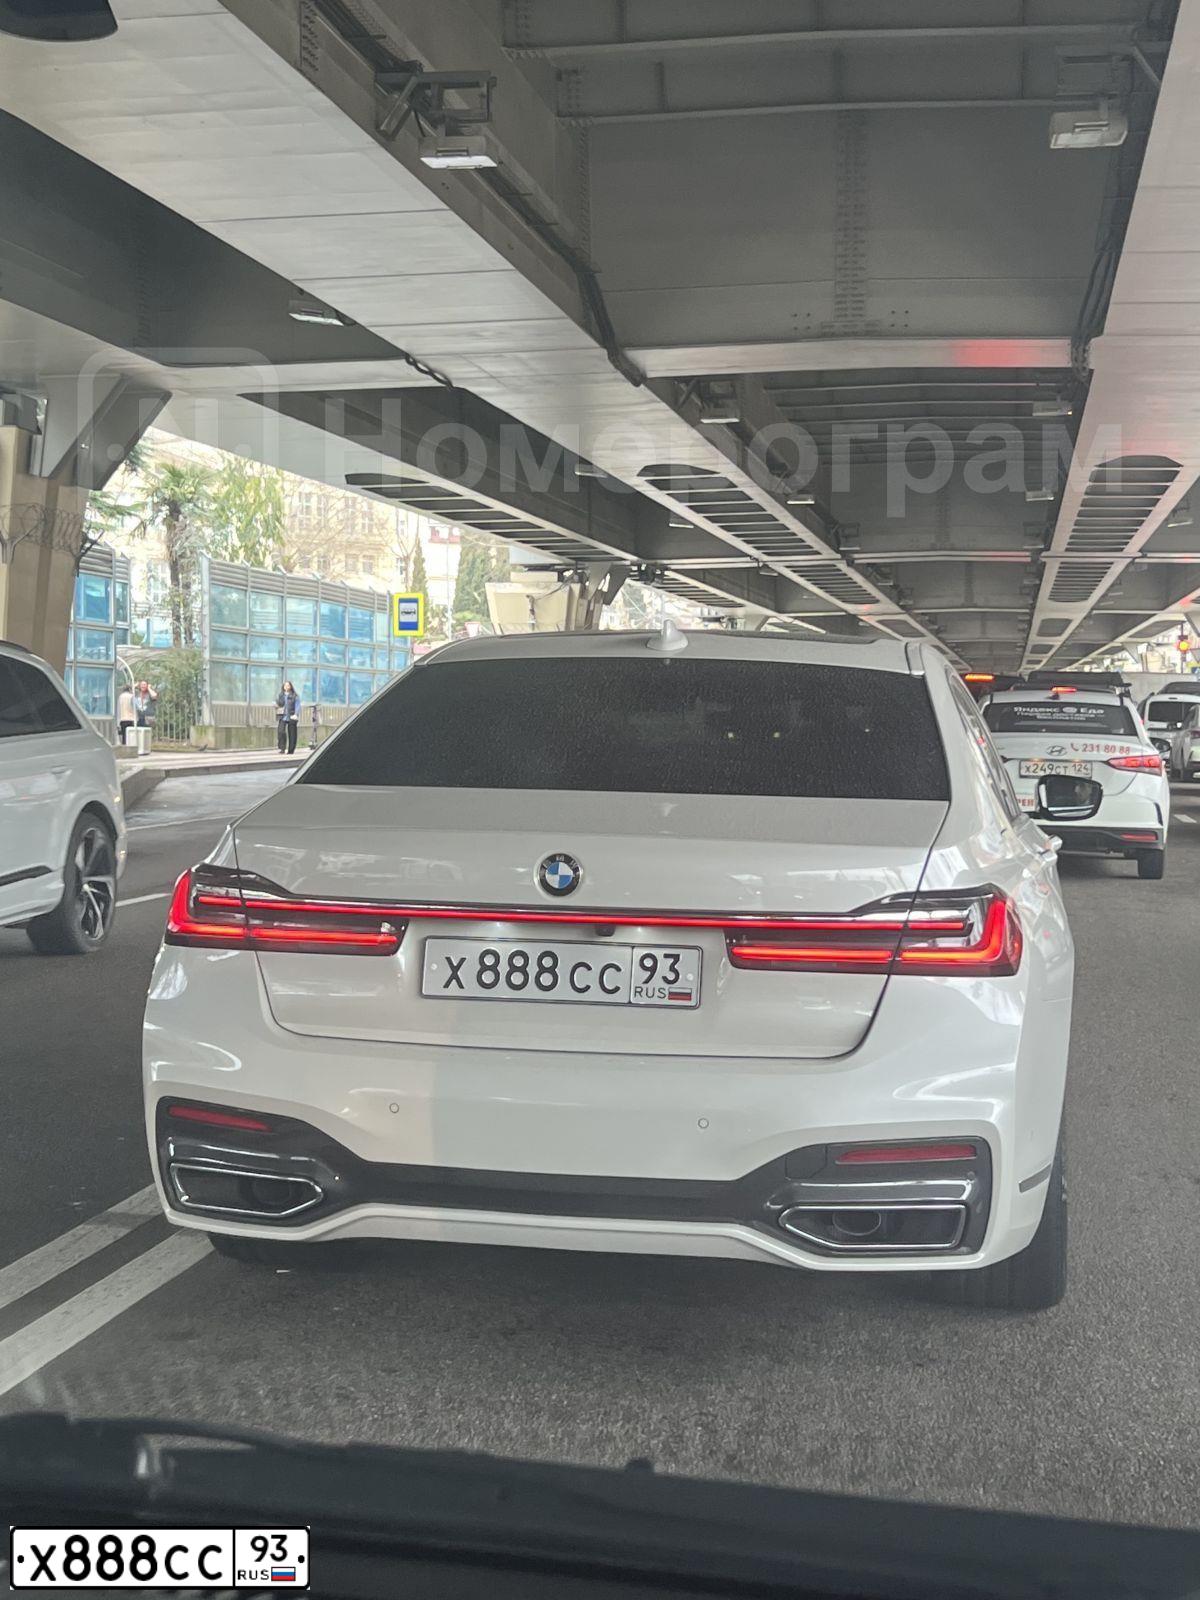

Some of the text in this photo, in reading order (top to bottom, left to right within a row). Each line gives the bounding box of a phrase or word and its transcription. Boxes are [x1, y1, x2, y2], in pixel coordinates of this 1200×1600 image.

[1081, 743, 1100, 753] 231
[1104, 744, 1116, 754] 80
[1072, 763, 1089, 772] 124
[639, 953, 681, 985] 93
[634, 987, 667, 999] RUS
